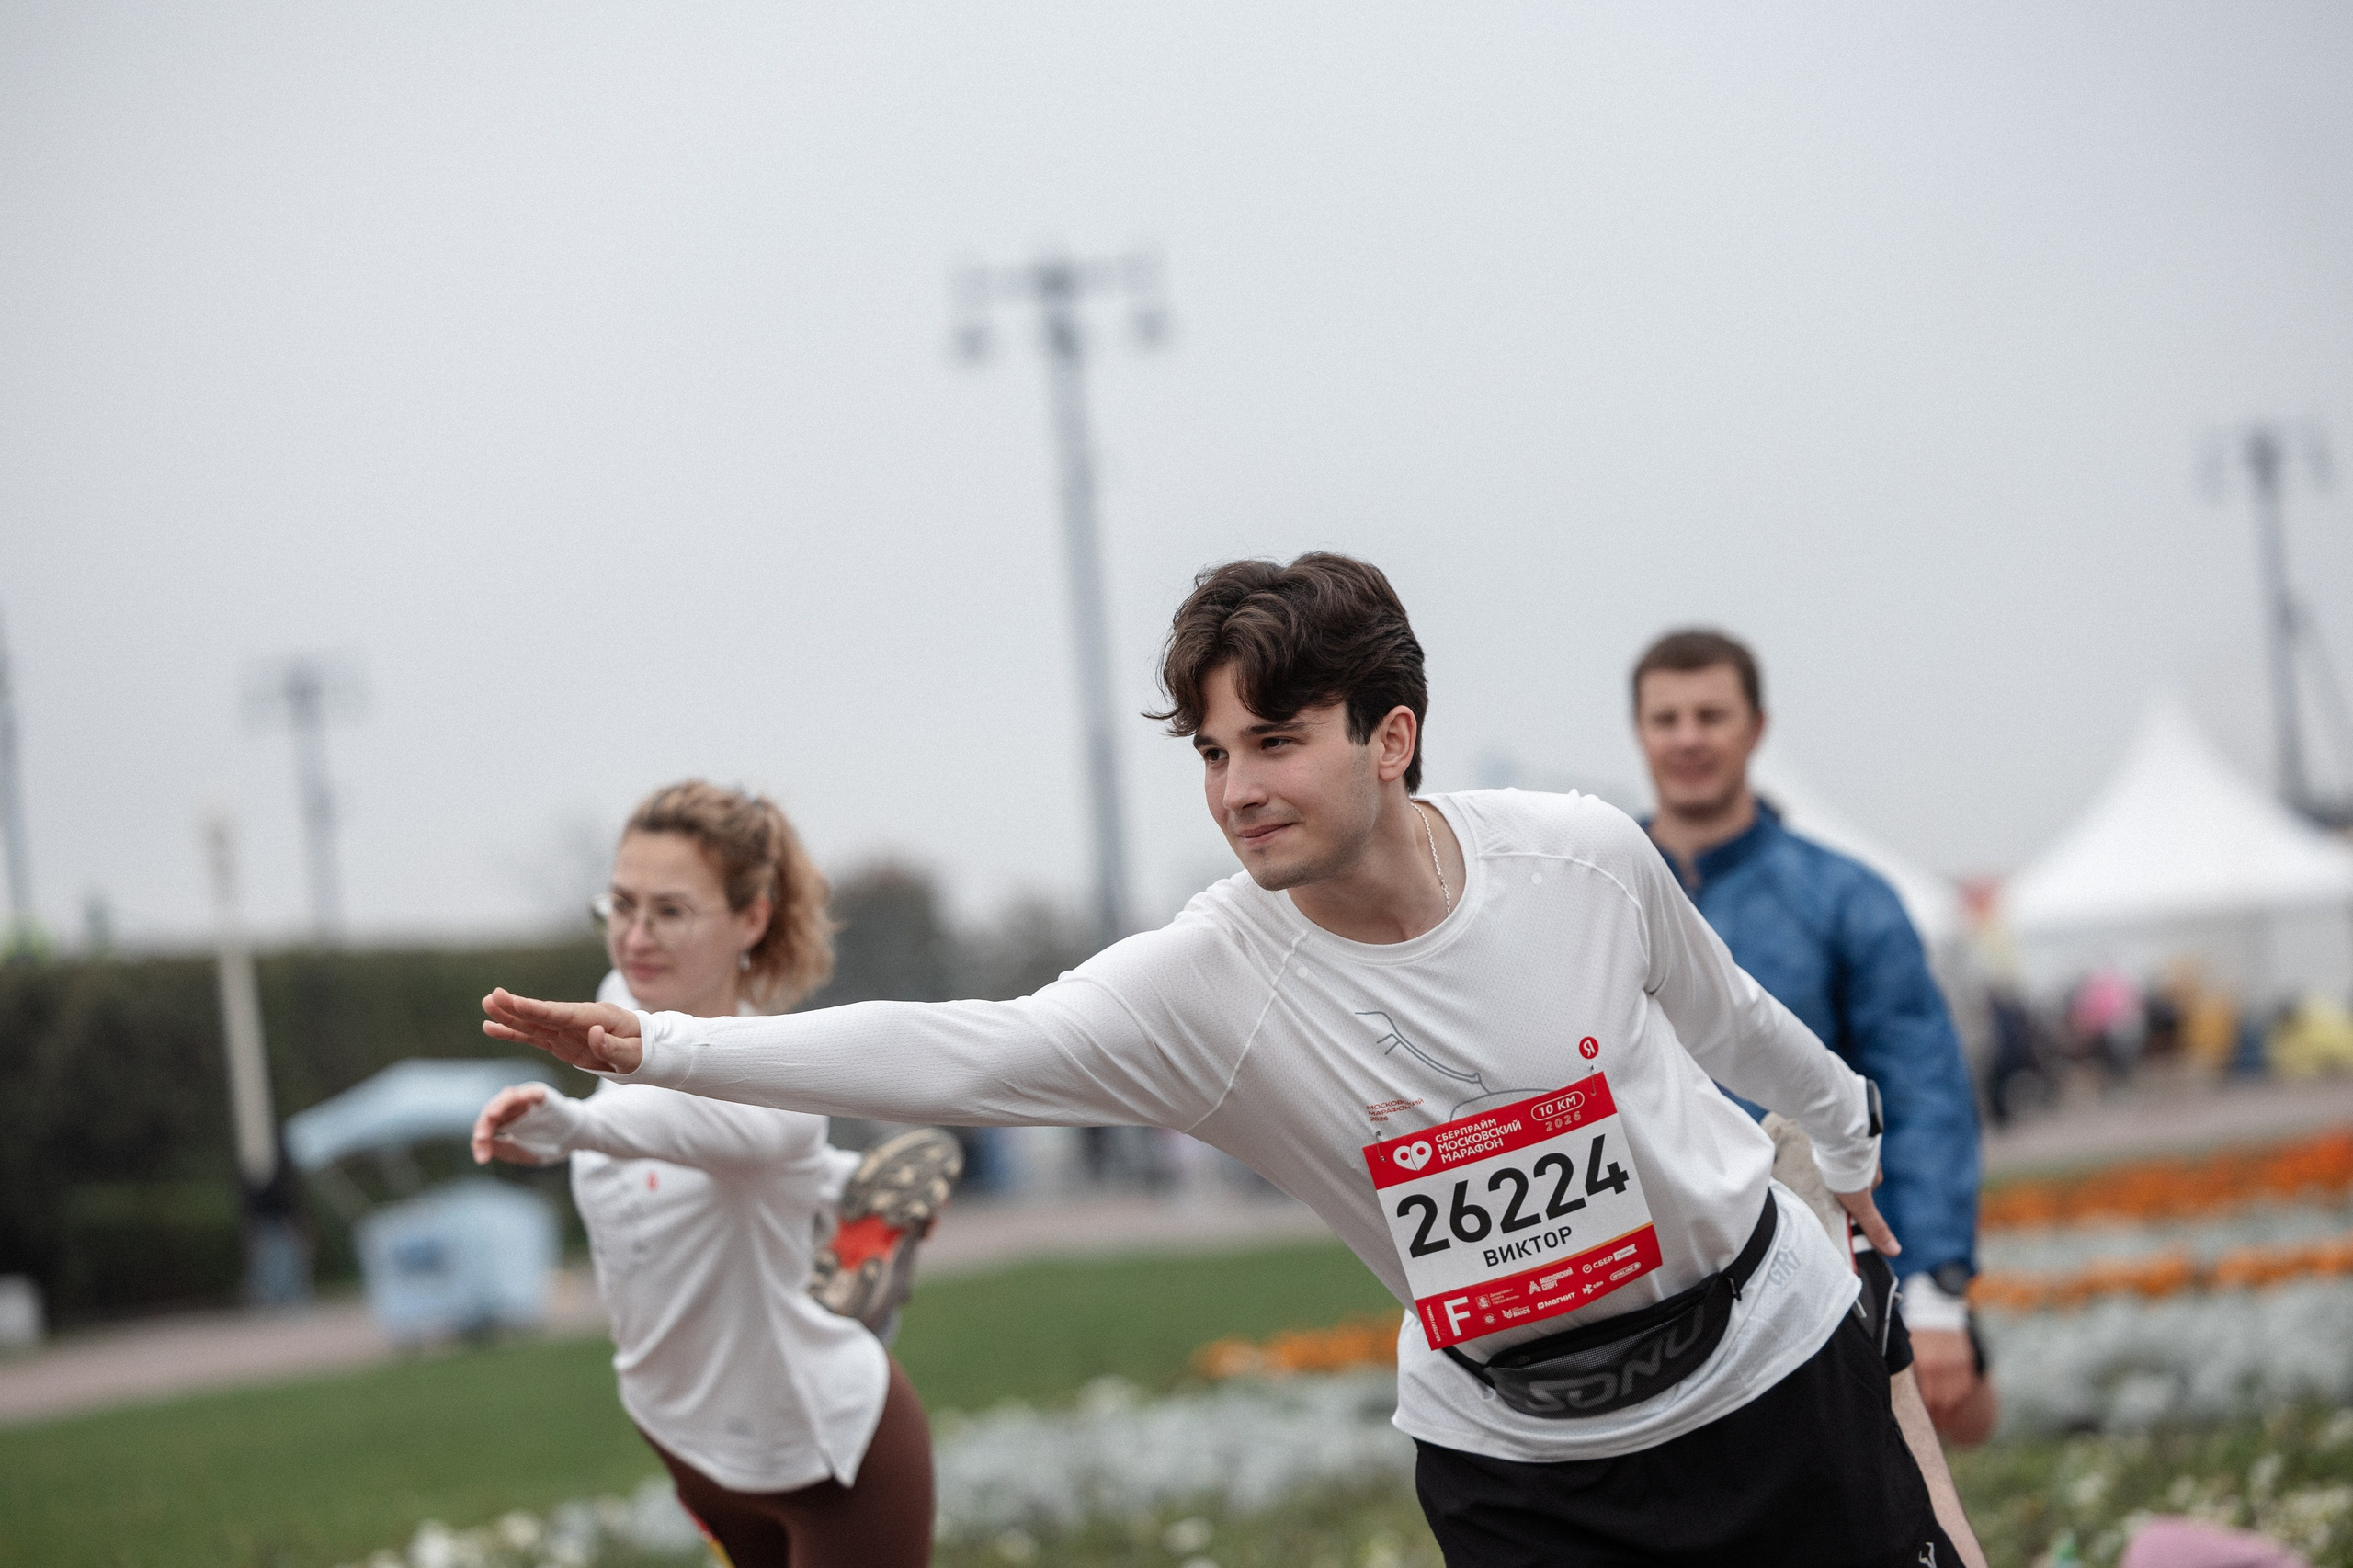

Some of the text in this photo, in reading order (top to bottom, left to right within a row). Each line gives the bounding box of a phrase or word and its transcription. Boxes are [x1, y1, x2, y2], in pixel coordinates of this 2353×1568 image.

[1368, 1105, 1412, 1116] МАРАФОН
[1539, 1104, 1554, 1117] 10
[1545, 1111, 1582, 1131] 2026
[1435, 1118, 1497, 1142] СБЕРПРАЙМ
[1438, 1119, 1522, 1153] МОСКОВСКИЙ
[1440, 1138, 1504, 1164] МАРАФОН
[1396, 1133, 1630, 1259] 26224
[1483, 1225, 1573, 1267] ВИКТОР
[1593, 1256, 1614, 1268] СБЕР
[1444, 1296, 1471, 1336] F
[1513, 1308, 1531, 1317] BRICS
